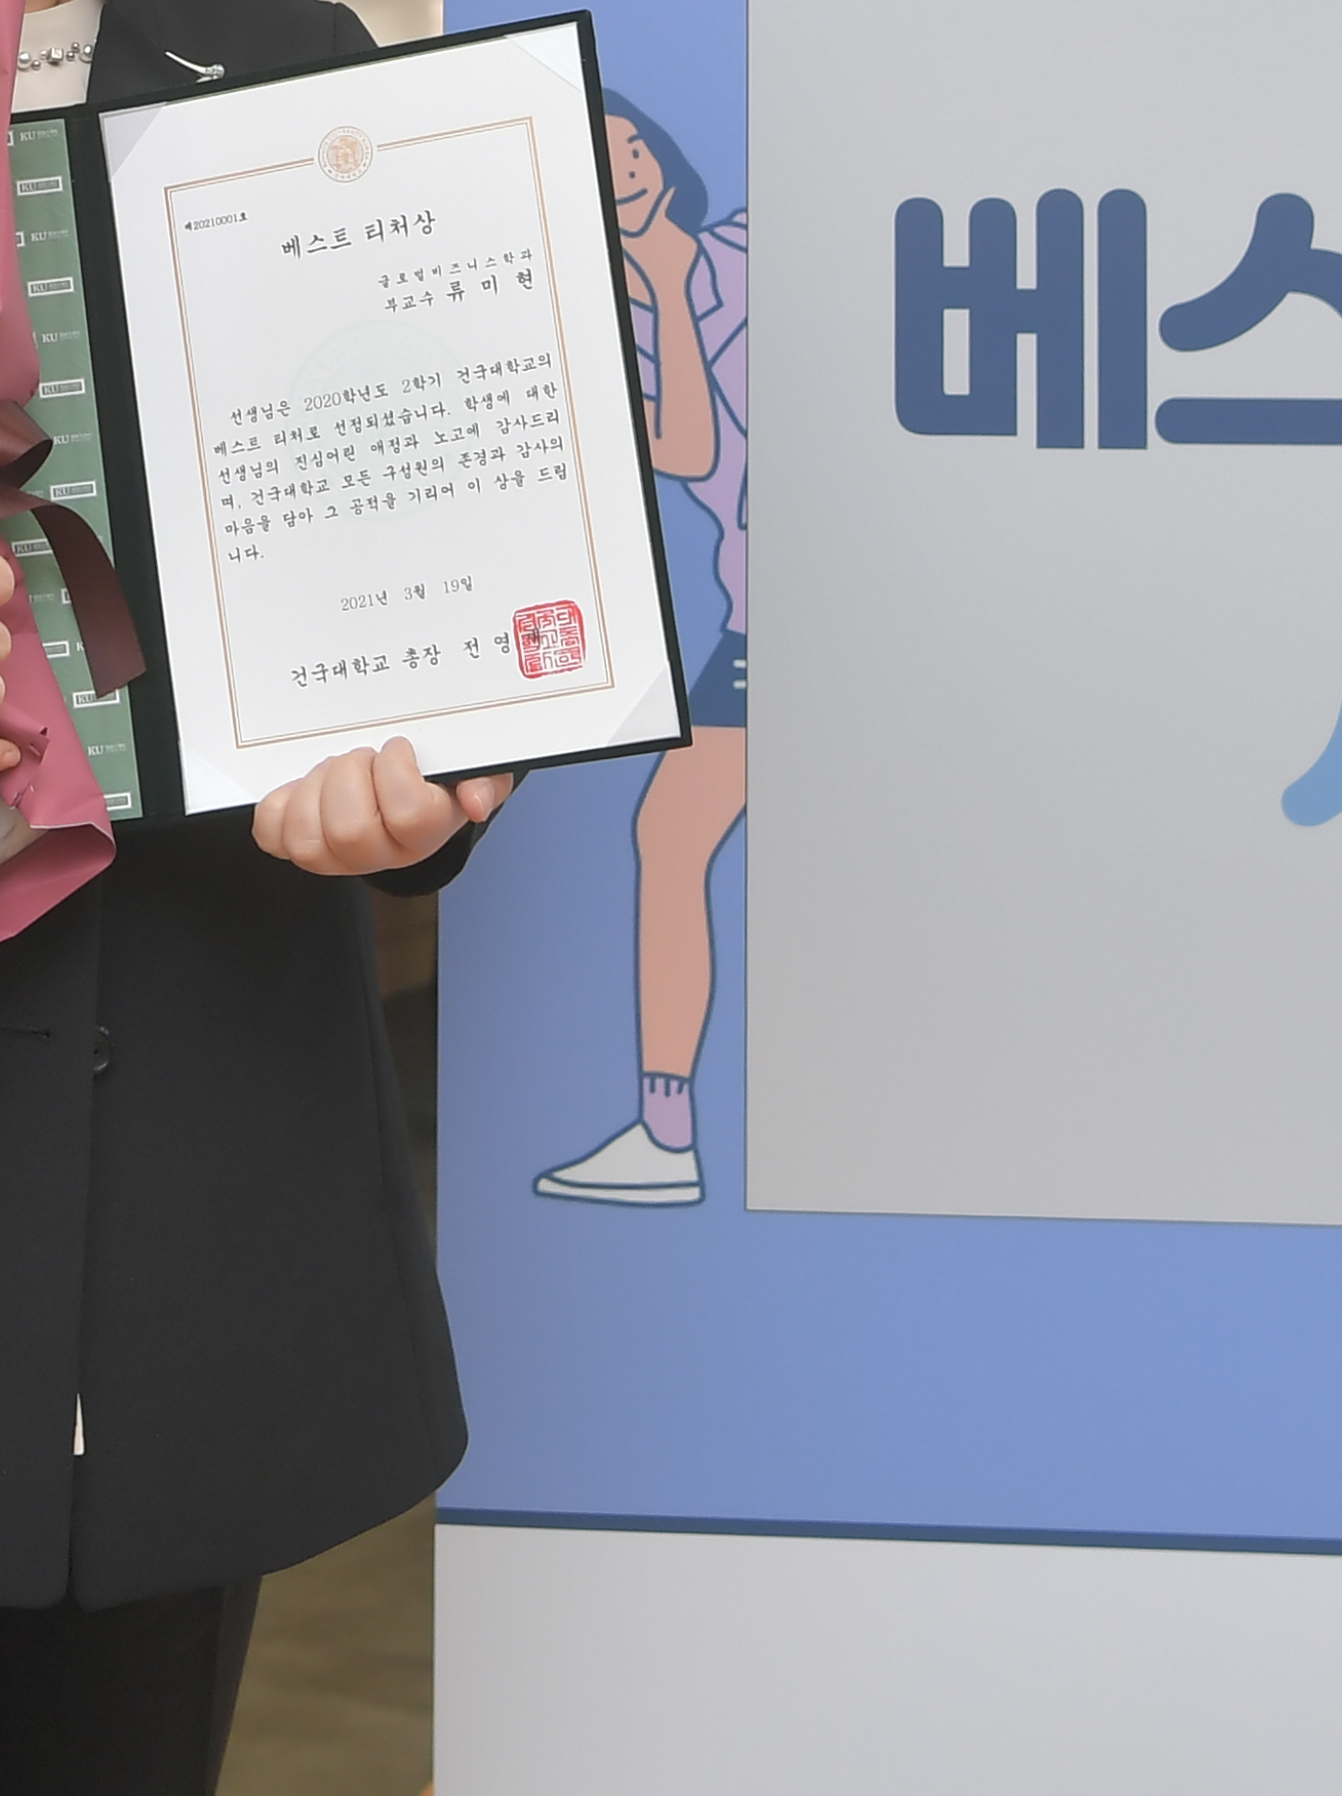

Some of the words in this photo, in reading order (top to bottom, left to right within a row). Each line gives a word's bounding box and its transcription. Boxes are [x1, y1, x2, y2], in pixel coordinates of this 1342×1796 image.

[280, 227, 352, 259] 베스트
[364, 209, 436, 244] 티처상
[384, 290, 434, 313] 부교수
[213, 436, 262, 457] 베스트
[334, 402, 451, 436] 선정되셨습니다.
[464, 389, 510, 412] 학생에
[526, 381, 558, 401] 대한
[230, 399, 291, 426] 선생님은
[304, 383, 389, 412] 2020학년도
[401, 372, 441, 394] 2학기
[456, 353, 551, 384] 건국대학교의
[218, 459, 279, 485] 선생님의
[295, 444, 356, 471] 진심어린
[370, 434, 419, 455] 애정과
[434, 422, 480, 445] 노고에
[496, 408, 560, 435] 감사드리
[221, 494, 242, 510] 며,
[251, 478, 331, 506] 건국대학교
[341, 469, 371, 490] 모든
[382, 455, 445, 481] 구성원의
[458, 446, 506, 469] 존경과
[516, 435, 564, 459] 감사의
[224, 514, 272, 537] 마음을
[282, 507, 314, 529] 담아
[324, 505, 339, 519] 그
[349, 492, 396, 516] 공적을
[408, 482, 455, 504] 기리어
[467, 477, 482, 493] 이
[494, 469, 525, 490] 상을
[537, 462, 567, 482] 드립
[227, 544, 265, 564] 니다.
[340, 589, 388, 611] 2021년
[443, 575, 473, 595] 19일
[291, 654, 390, 688] 건국대학교
[401, 643, 442, 670] 총장
